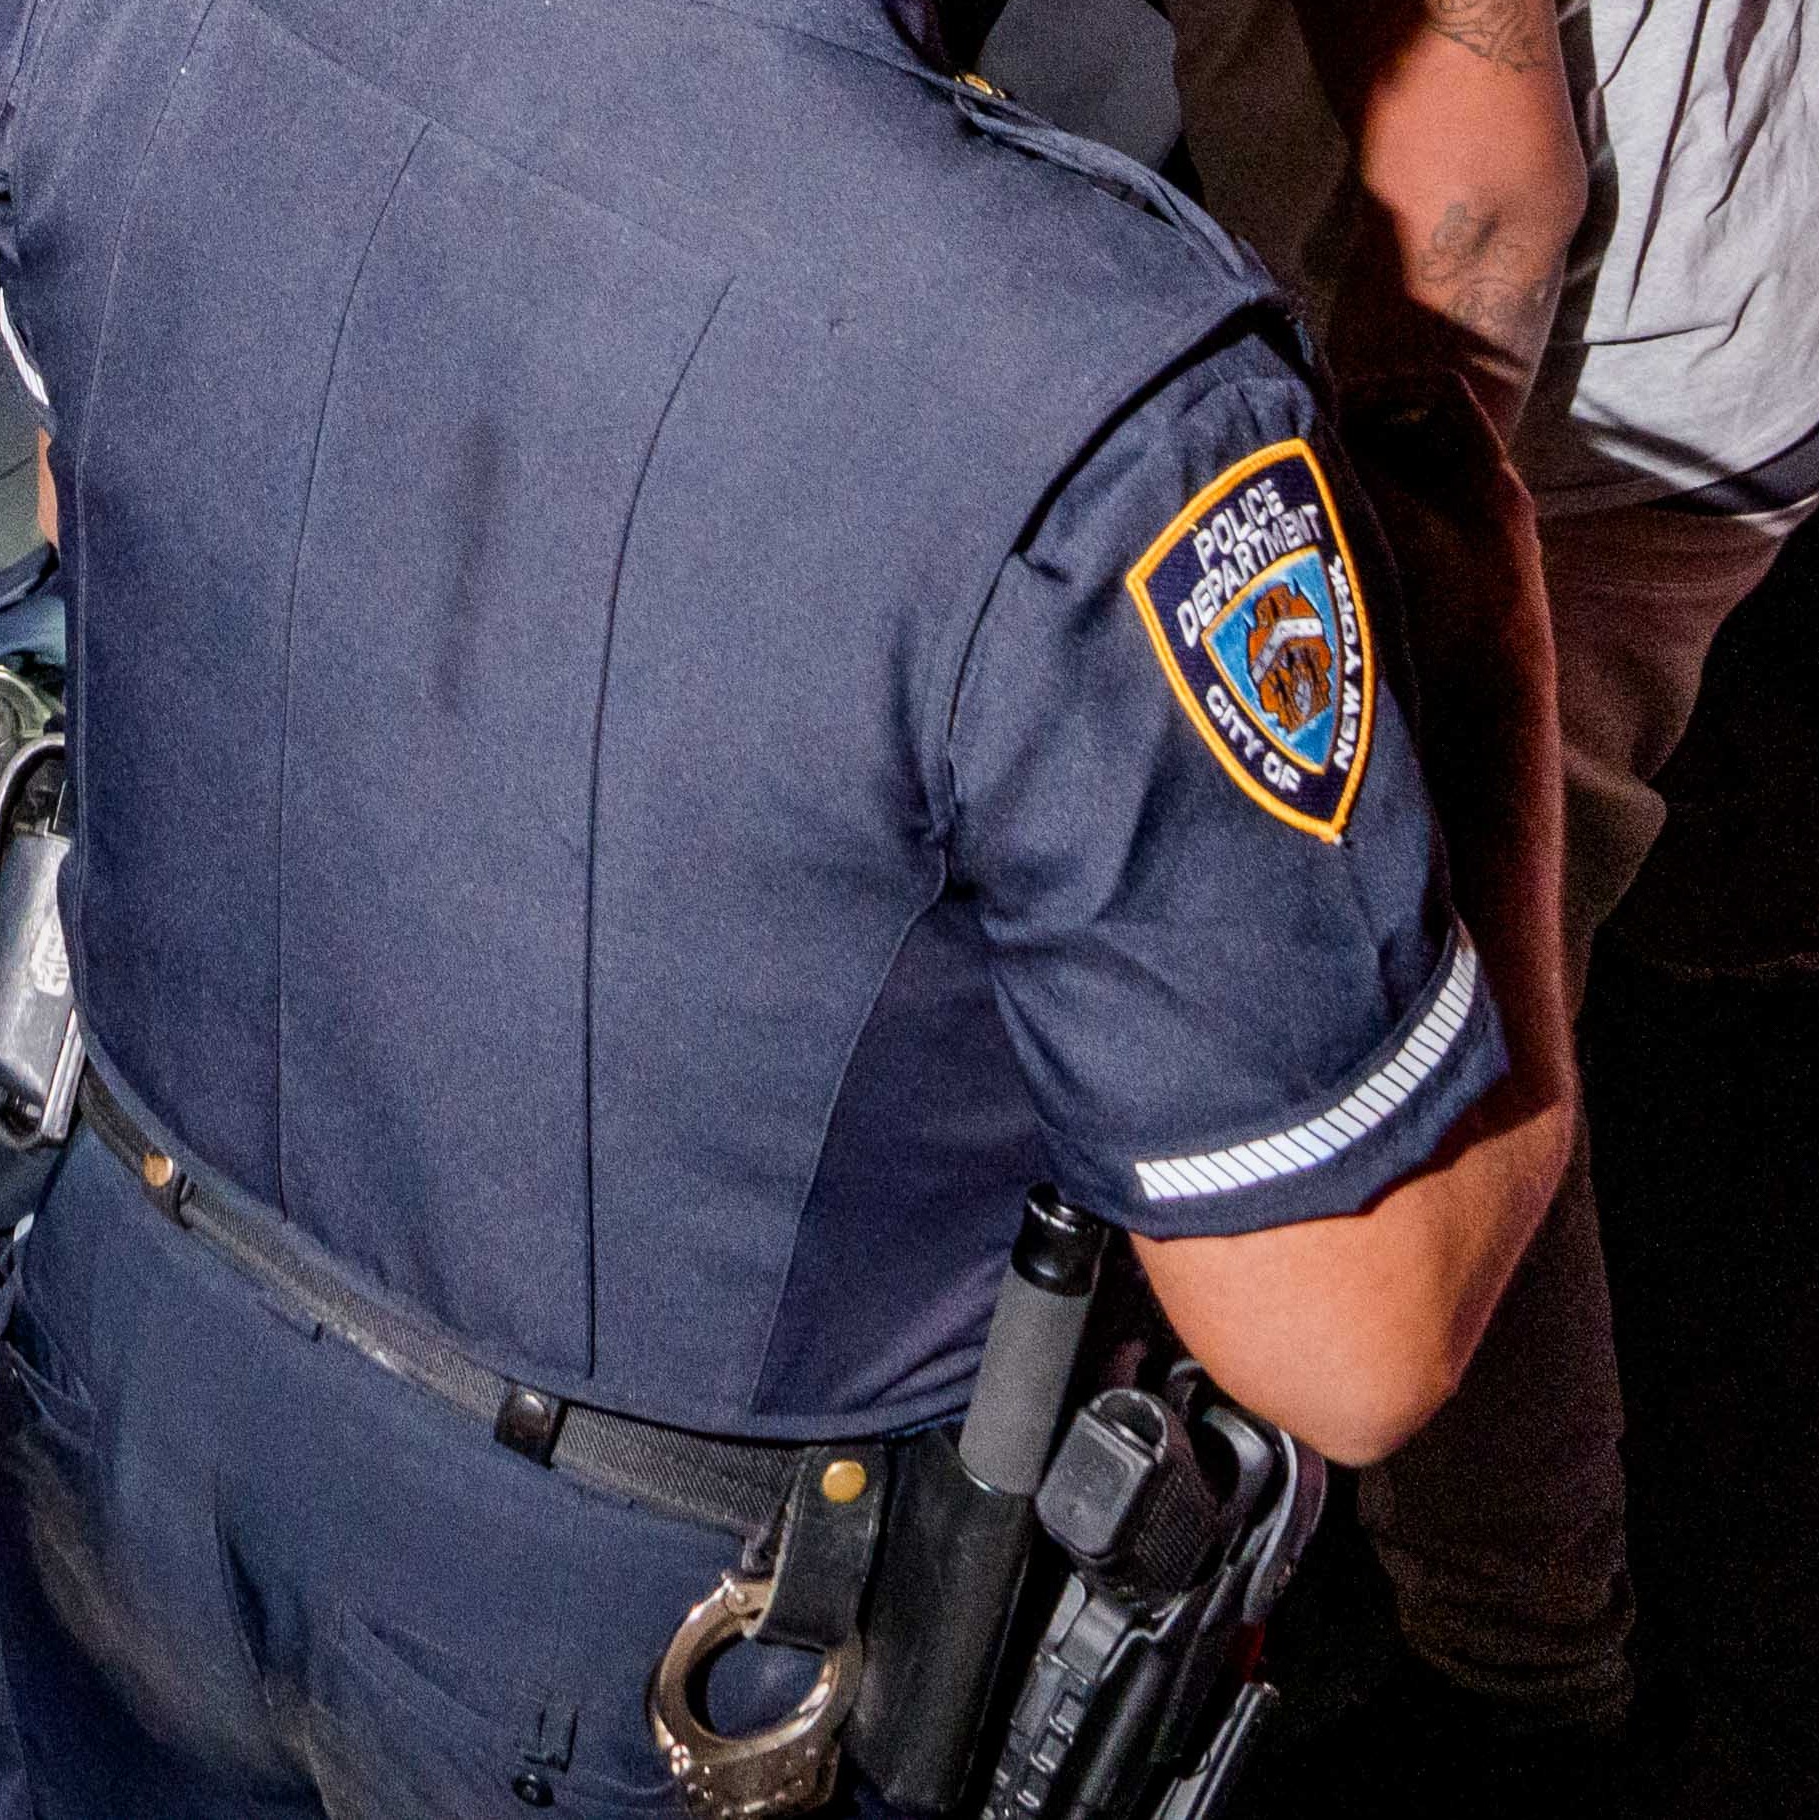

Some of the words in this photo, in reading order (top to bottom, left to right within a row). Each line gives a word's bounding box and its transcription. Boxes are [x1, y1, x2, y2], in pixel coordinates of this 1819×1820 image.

[1177, 504, 1323, 649] DEPARTMENT
[1192, 478, 1284, 573] POLICE
[1327, 554, 1362, 677] YORK
[1205, 683, 1265, 760] CITY
[1262, 751, 1302, 793] OF
[1333, 679, 1361, 772] NEW
